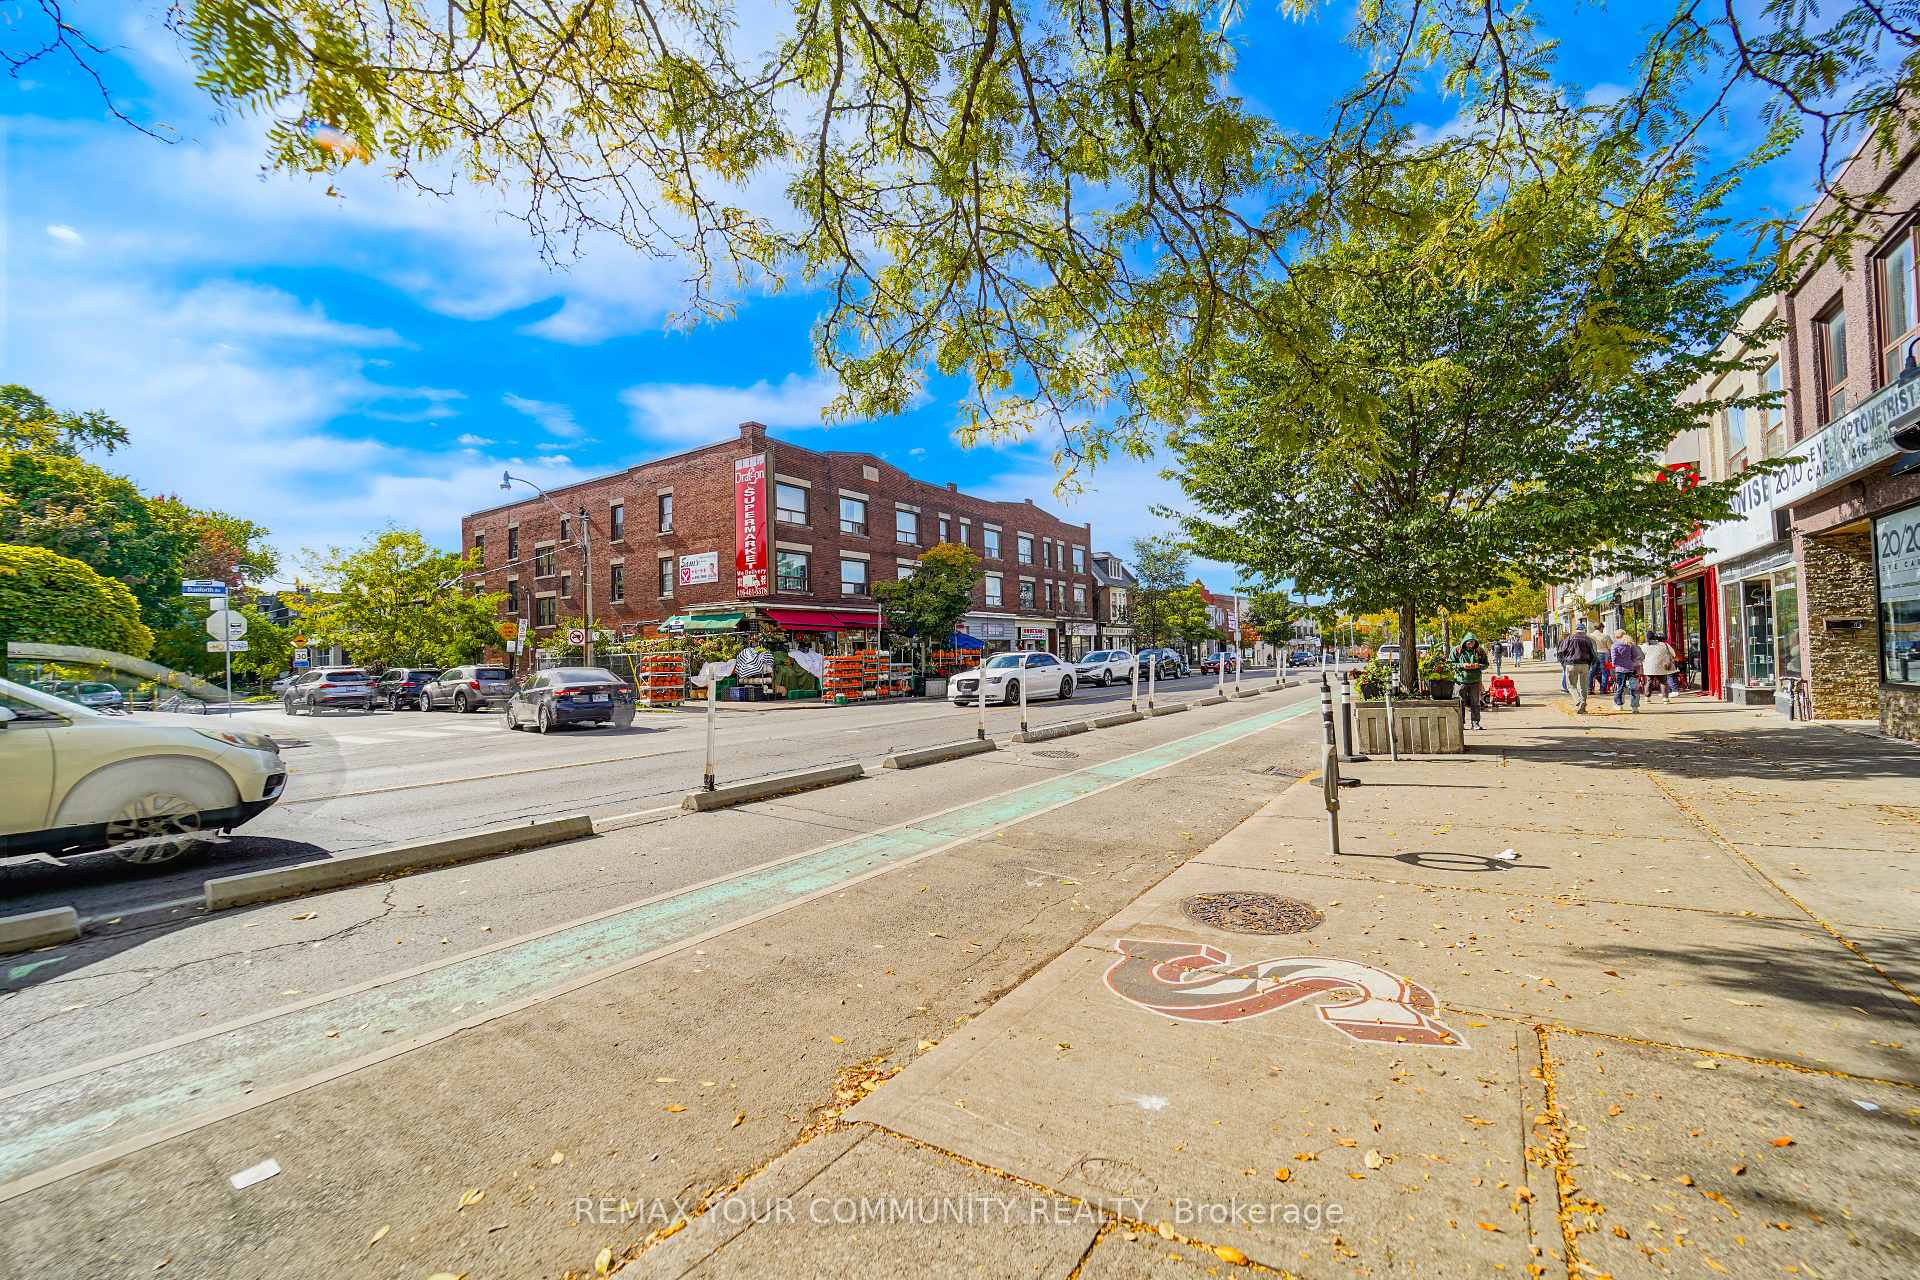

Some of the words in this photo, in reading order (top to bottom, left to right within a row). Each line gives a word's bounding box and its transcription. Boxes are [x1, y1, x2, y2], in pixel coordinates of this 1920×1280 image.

[1840, 384, 1915, 444] OPTOMETRIST
[1807, 456, 1836, 482] CARE
[1809, 438, 1829, 463] EYE
[744, 487, 756, 569] SUPERMARKET
